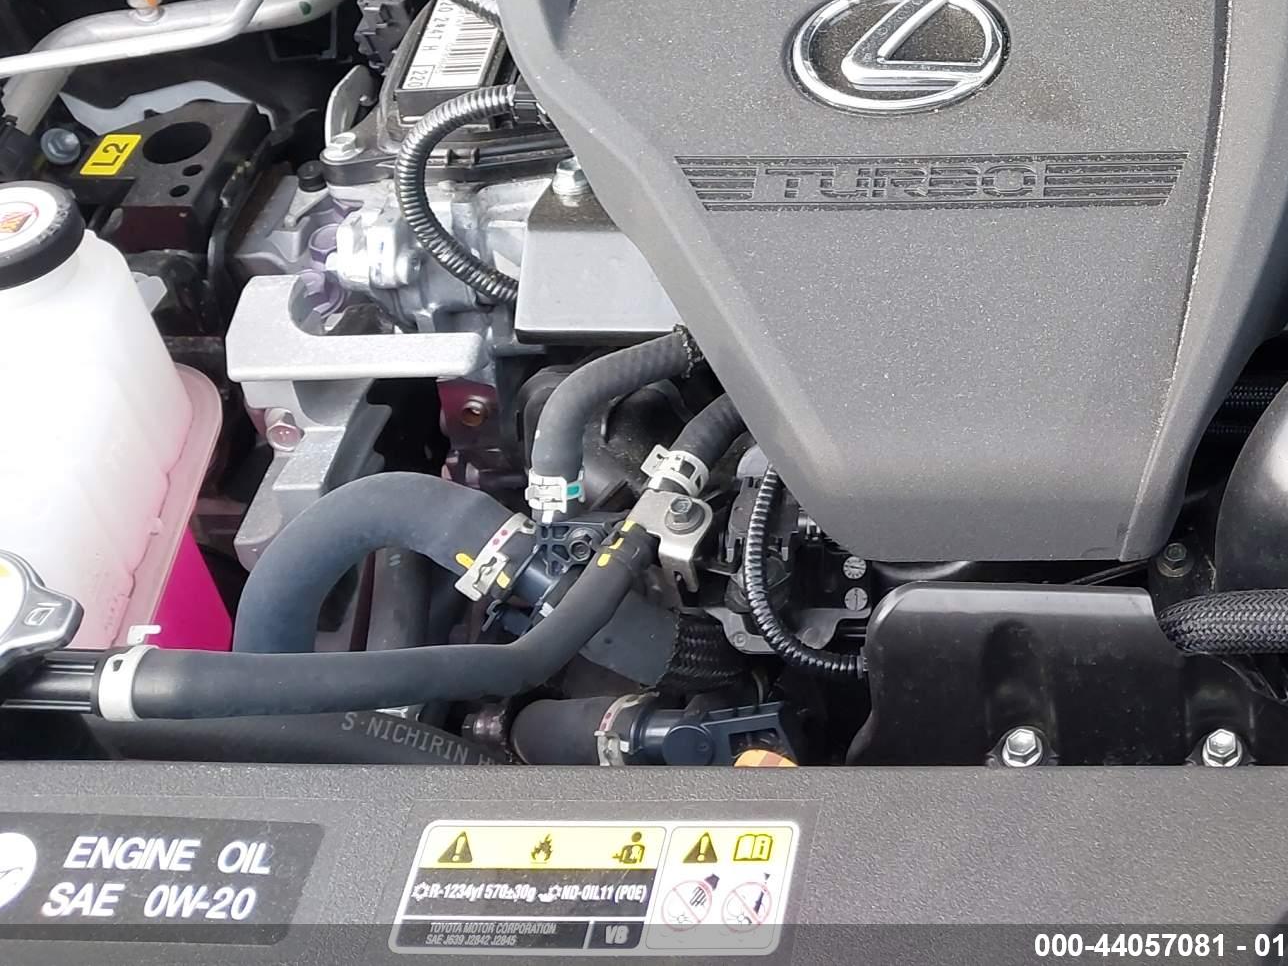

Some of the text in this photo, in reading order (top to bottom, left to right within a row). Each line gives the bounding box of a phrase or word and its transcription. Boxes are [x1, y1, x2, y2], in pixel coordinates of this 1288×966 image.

[91, 143, 130, 166] L2
[764, 165, 1037, 198] TURBO
[64, 836, 273, 875] ENGINE OIL
[42, 882, 257, 921] SAE 0W-20
[426, 934, 444, 945] SAE
[444, 934, 465, 945] J639
[430, 922, 556, 935] TOYOTA MOTOR CORPORATION
